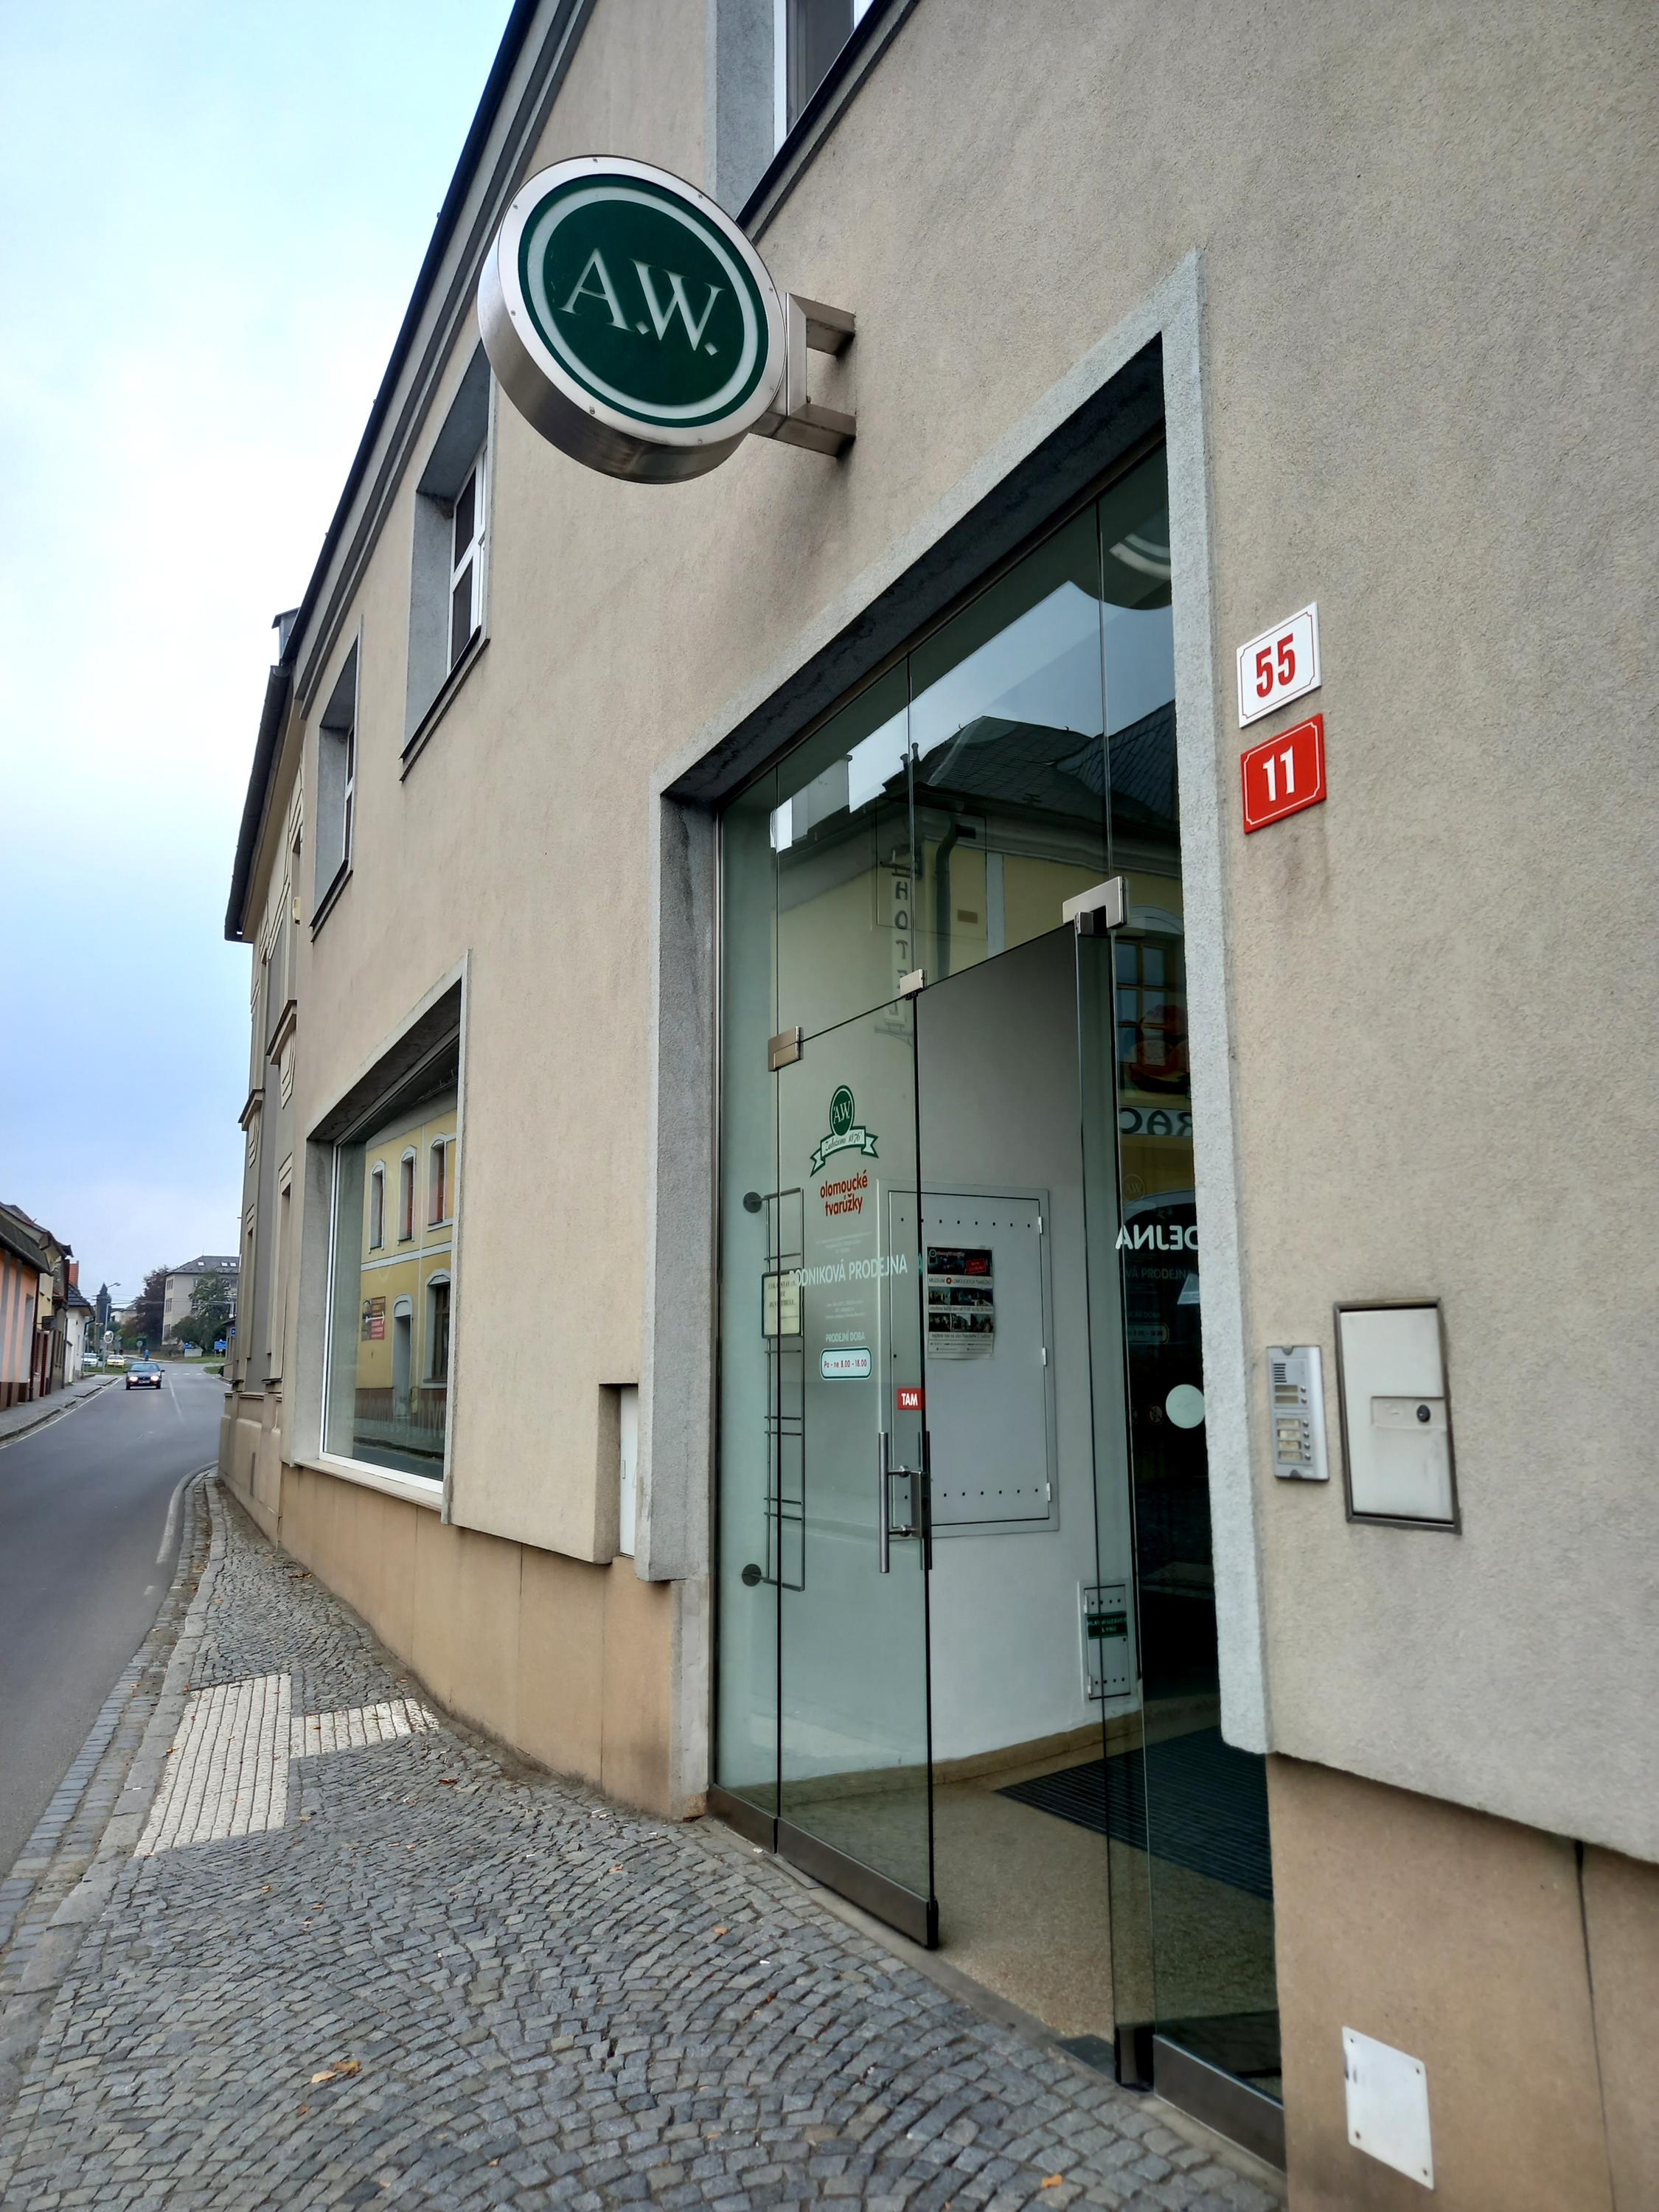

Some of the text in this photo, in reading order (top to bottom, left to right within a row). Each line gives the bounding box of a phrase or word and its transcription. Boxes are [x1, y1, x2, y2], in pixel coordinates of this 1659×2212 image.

[558, 247, 726, 356] A.W.
[1256, 632, 1295, 698] 55
[1262, 745, 1295, 802] 11
[820, 1169, 868, 1199] olomoucké
[824, 1192, 863, 1217] tvarůžky
[849, 1253, 908, 1281] PRODEJNA
[825, 1330, 866, 1343] PRODEJNÍ DOBA
[901, 1392, 918, 1407] TAM
